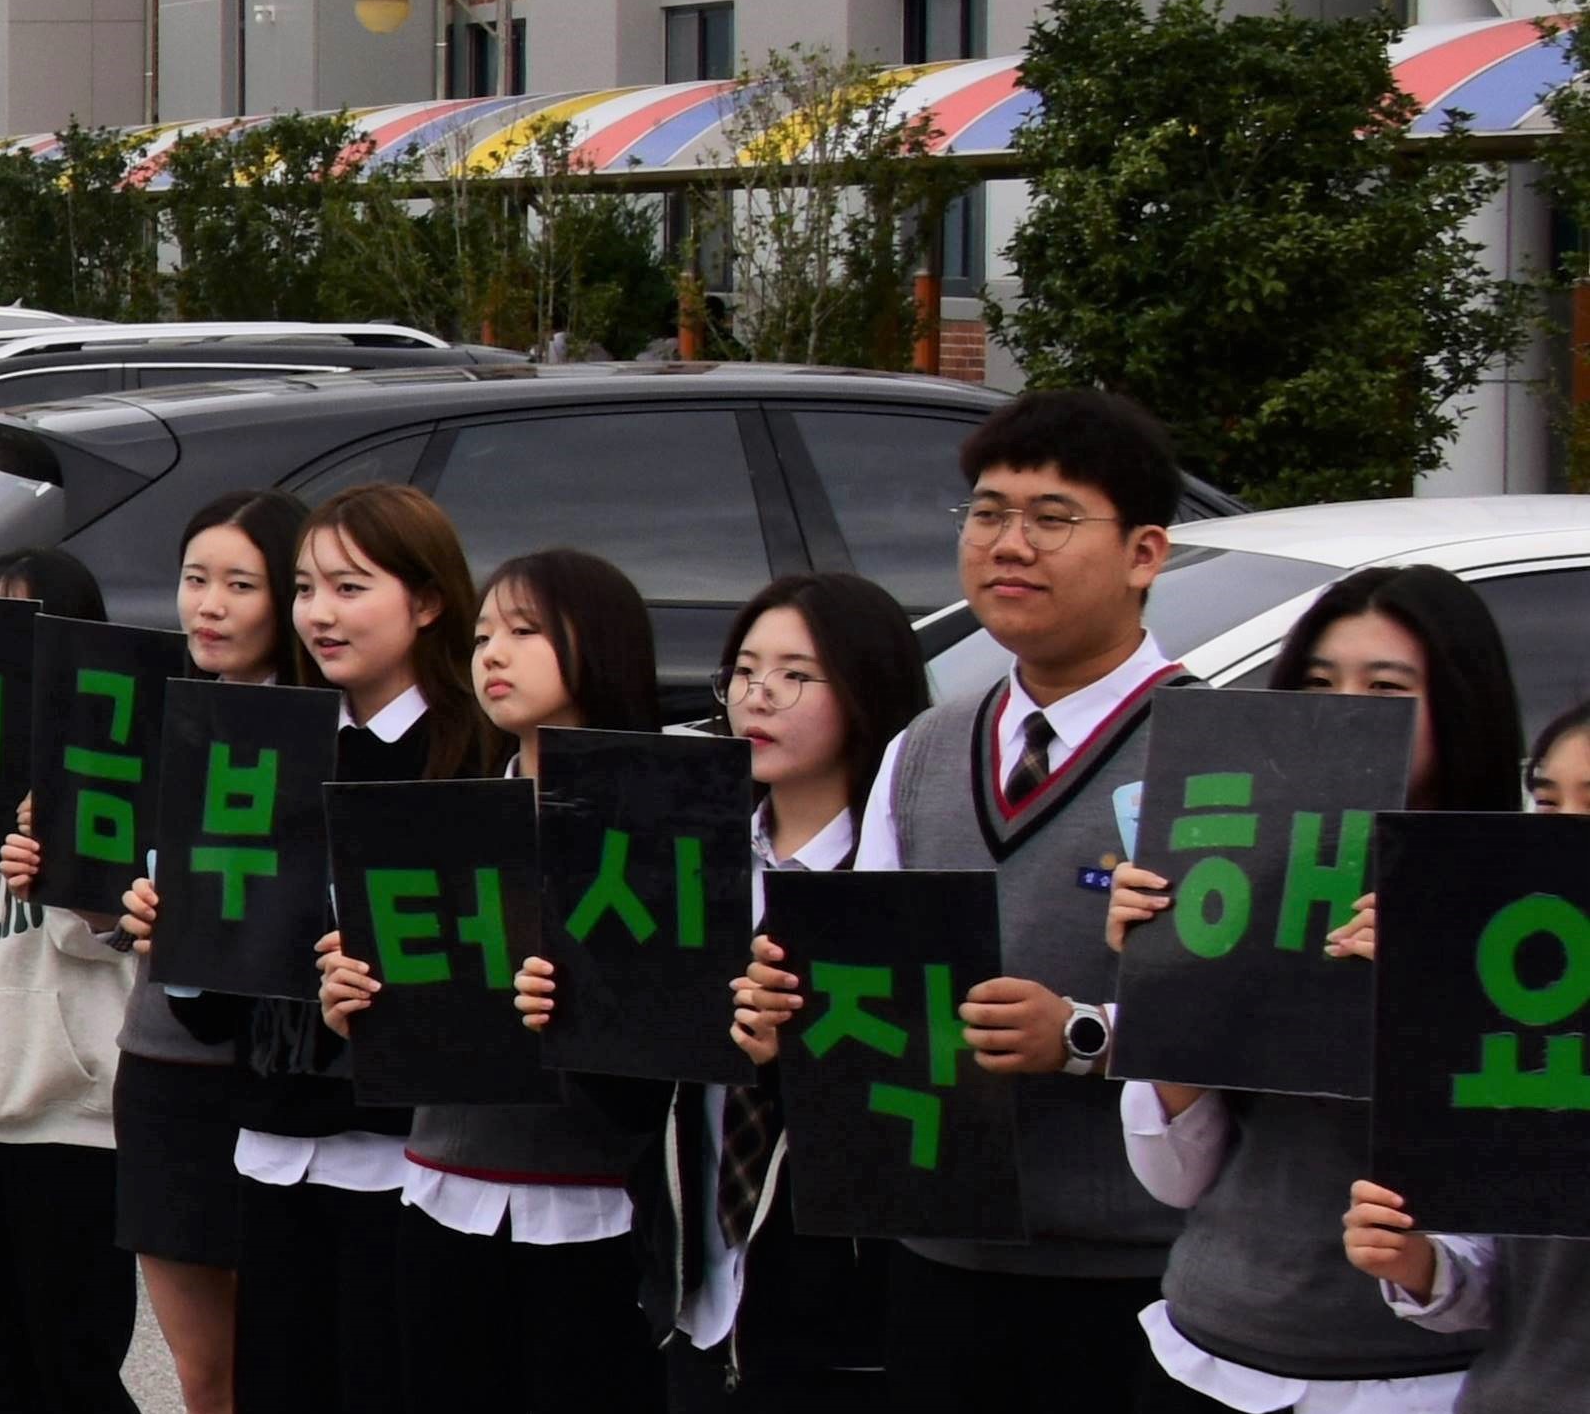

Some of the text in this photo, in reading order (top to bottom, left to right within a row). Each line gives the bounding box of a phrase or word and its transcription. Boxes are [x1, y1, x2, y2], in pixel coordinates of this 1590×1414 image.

[61, 669, 145, 864] 금
[189, 740, 282, 924] 부
[365, 867, 511, 989] 터
[563, 828, 705, 950] 시
[1170, 771, 1374, 959] 해
[800, 959, 977, 1171] 작
[1450, 892, 1590, 1111] 요
